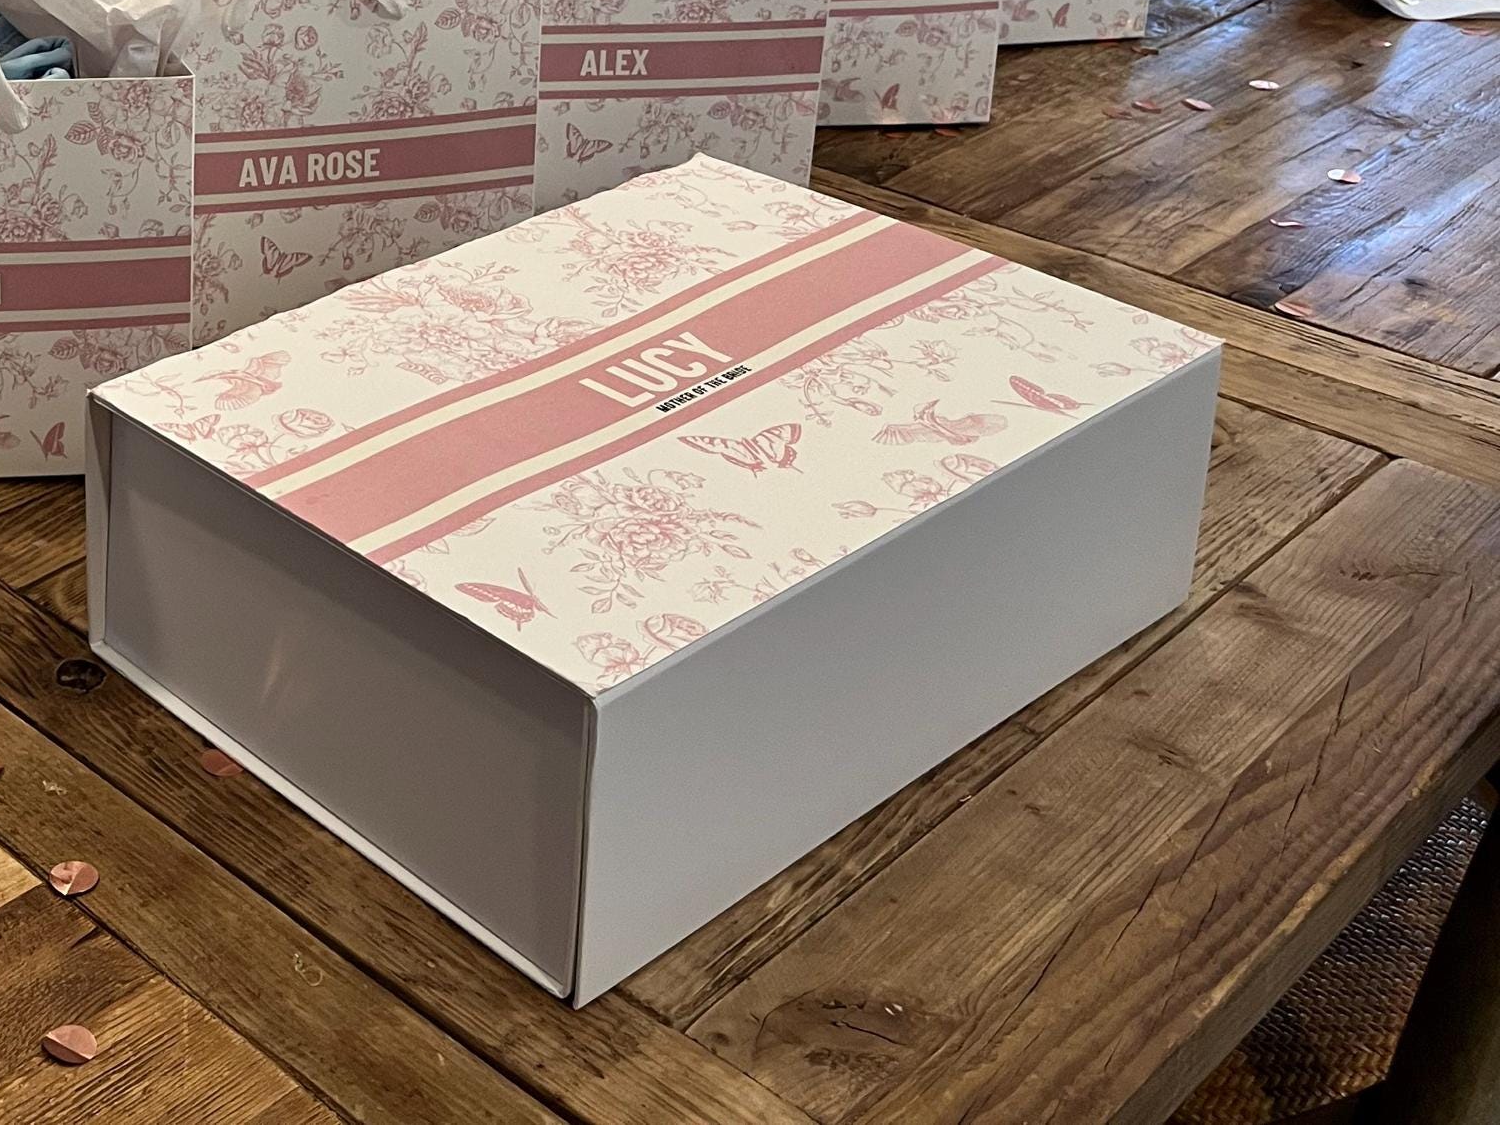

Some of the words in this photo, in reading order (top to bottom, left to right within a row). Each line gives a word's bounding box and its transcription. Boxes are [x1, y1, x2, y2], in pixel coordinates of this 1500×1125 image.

[579, 48, 650, 77] ALEX
[238, 155, 298, 188] AVA
[307, 148, 381, 183] ROSE
[578, 331, 733, 408] LUCY
[655, 391, 698, 413] MOTHER
[691, 385, 708, 396] OF
[704, 377, 728, 389] THE
[721, 364, 753, 381] BRIDE
